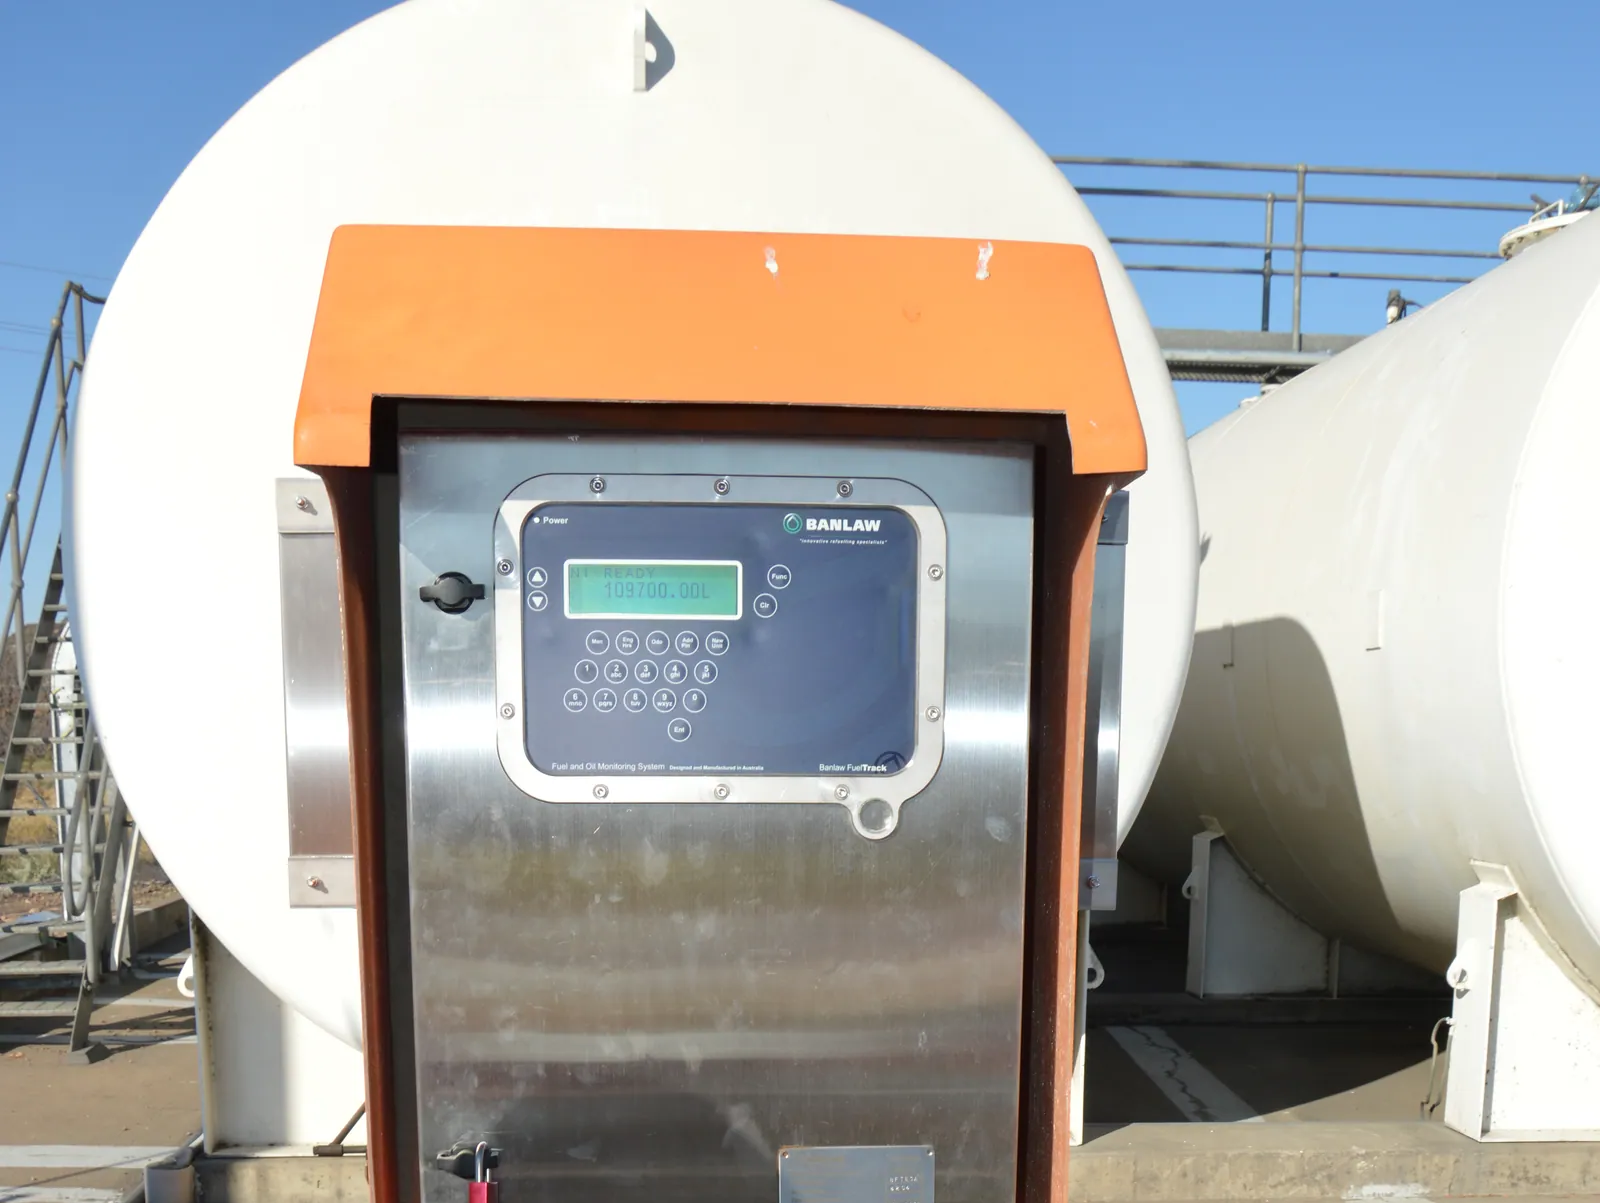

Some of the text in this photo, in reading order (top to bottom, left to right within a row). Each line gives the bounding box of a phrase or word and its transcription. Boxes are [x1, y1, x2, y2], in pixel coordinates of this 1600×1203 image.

[543, 516, 568, 524] Power
[806, 518, 881, 532] BANLAW
[604, 567, 655, 579] READY
[604, 582, 710, 599] 109700.00L
[598, 762, 635, 771] Monitoring
[638, 762, 665, 771] System
